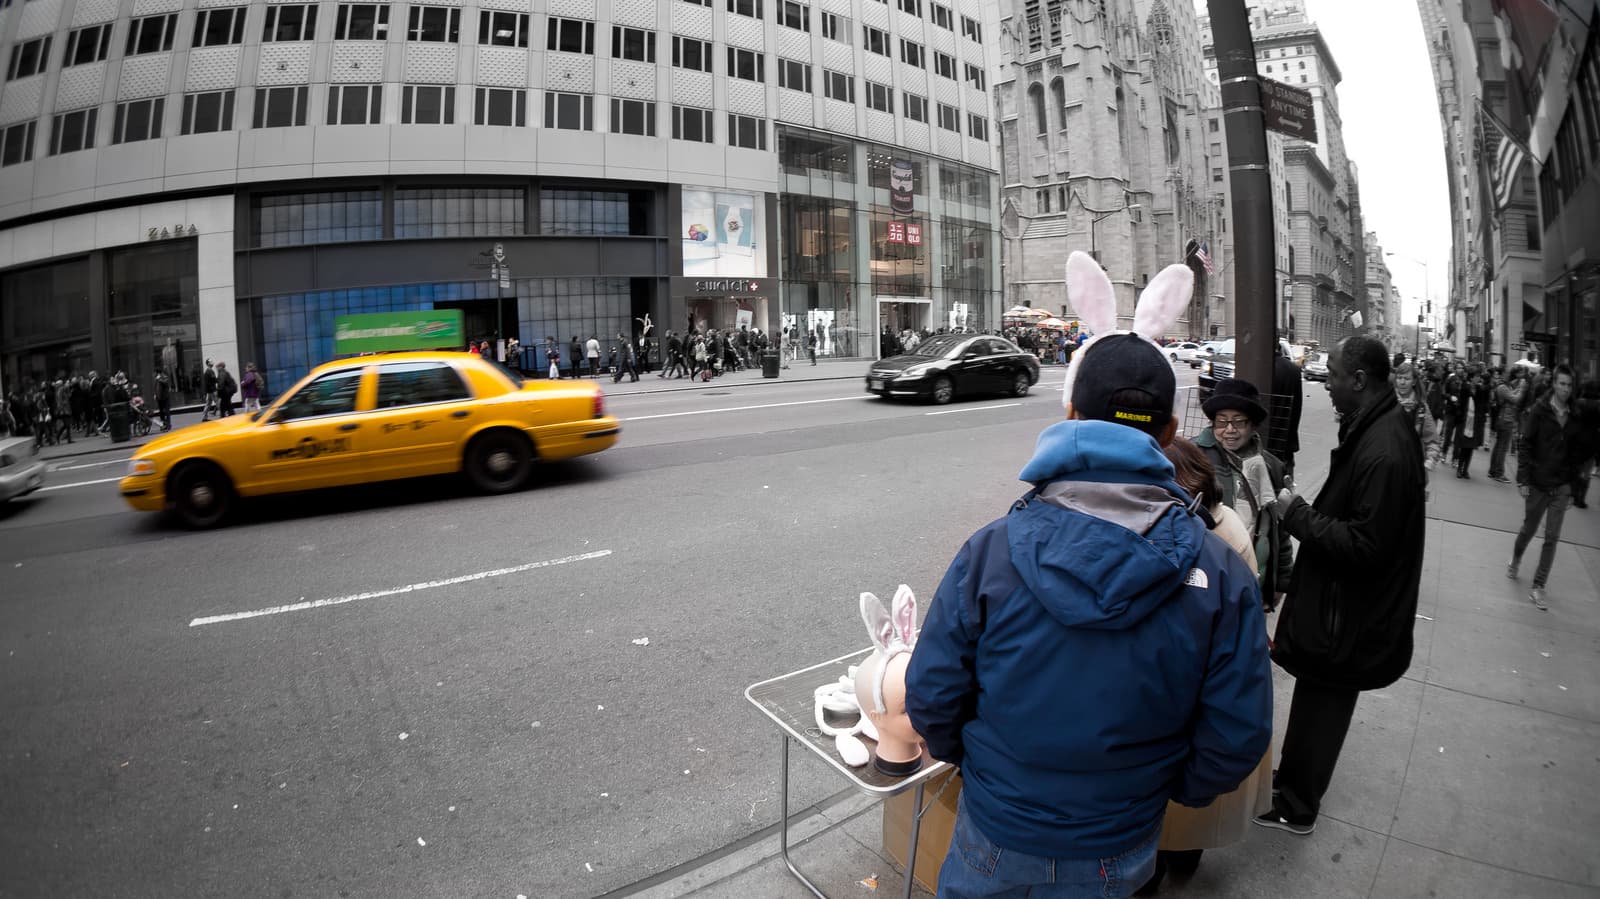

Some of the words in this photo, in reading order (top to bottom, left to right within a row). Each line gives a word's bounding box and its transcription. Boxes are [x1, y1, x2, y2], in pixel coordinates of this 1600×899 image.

[1275, 86, 1312, 107] STANDING
[1271, 99, 1308, 119] ANYTIME
[148, 224, 198, 238] ZARA
[695, 279, 749, 292] swatch
[1114, 411, 1152, 422] MARINES
